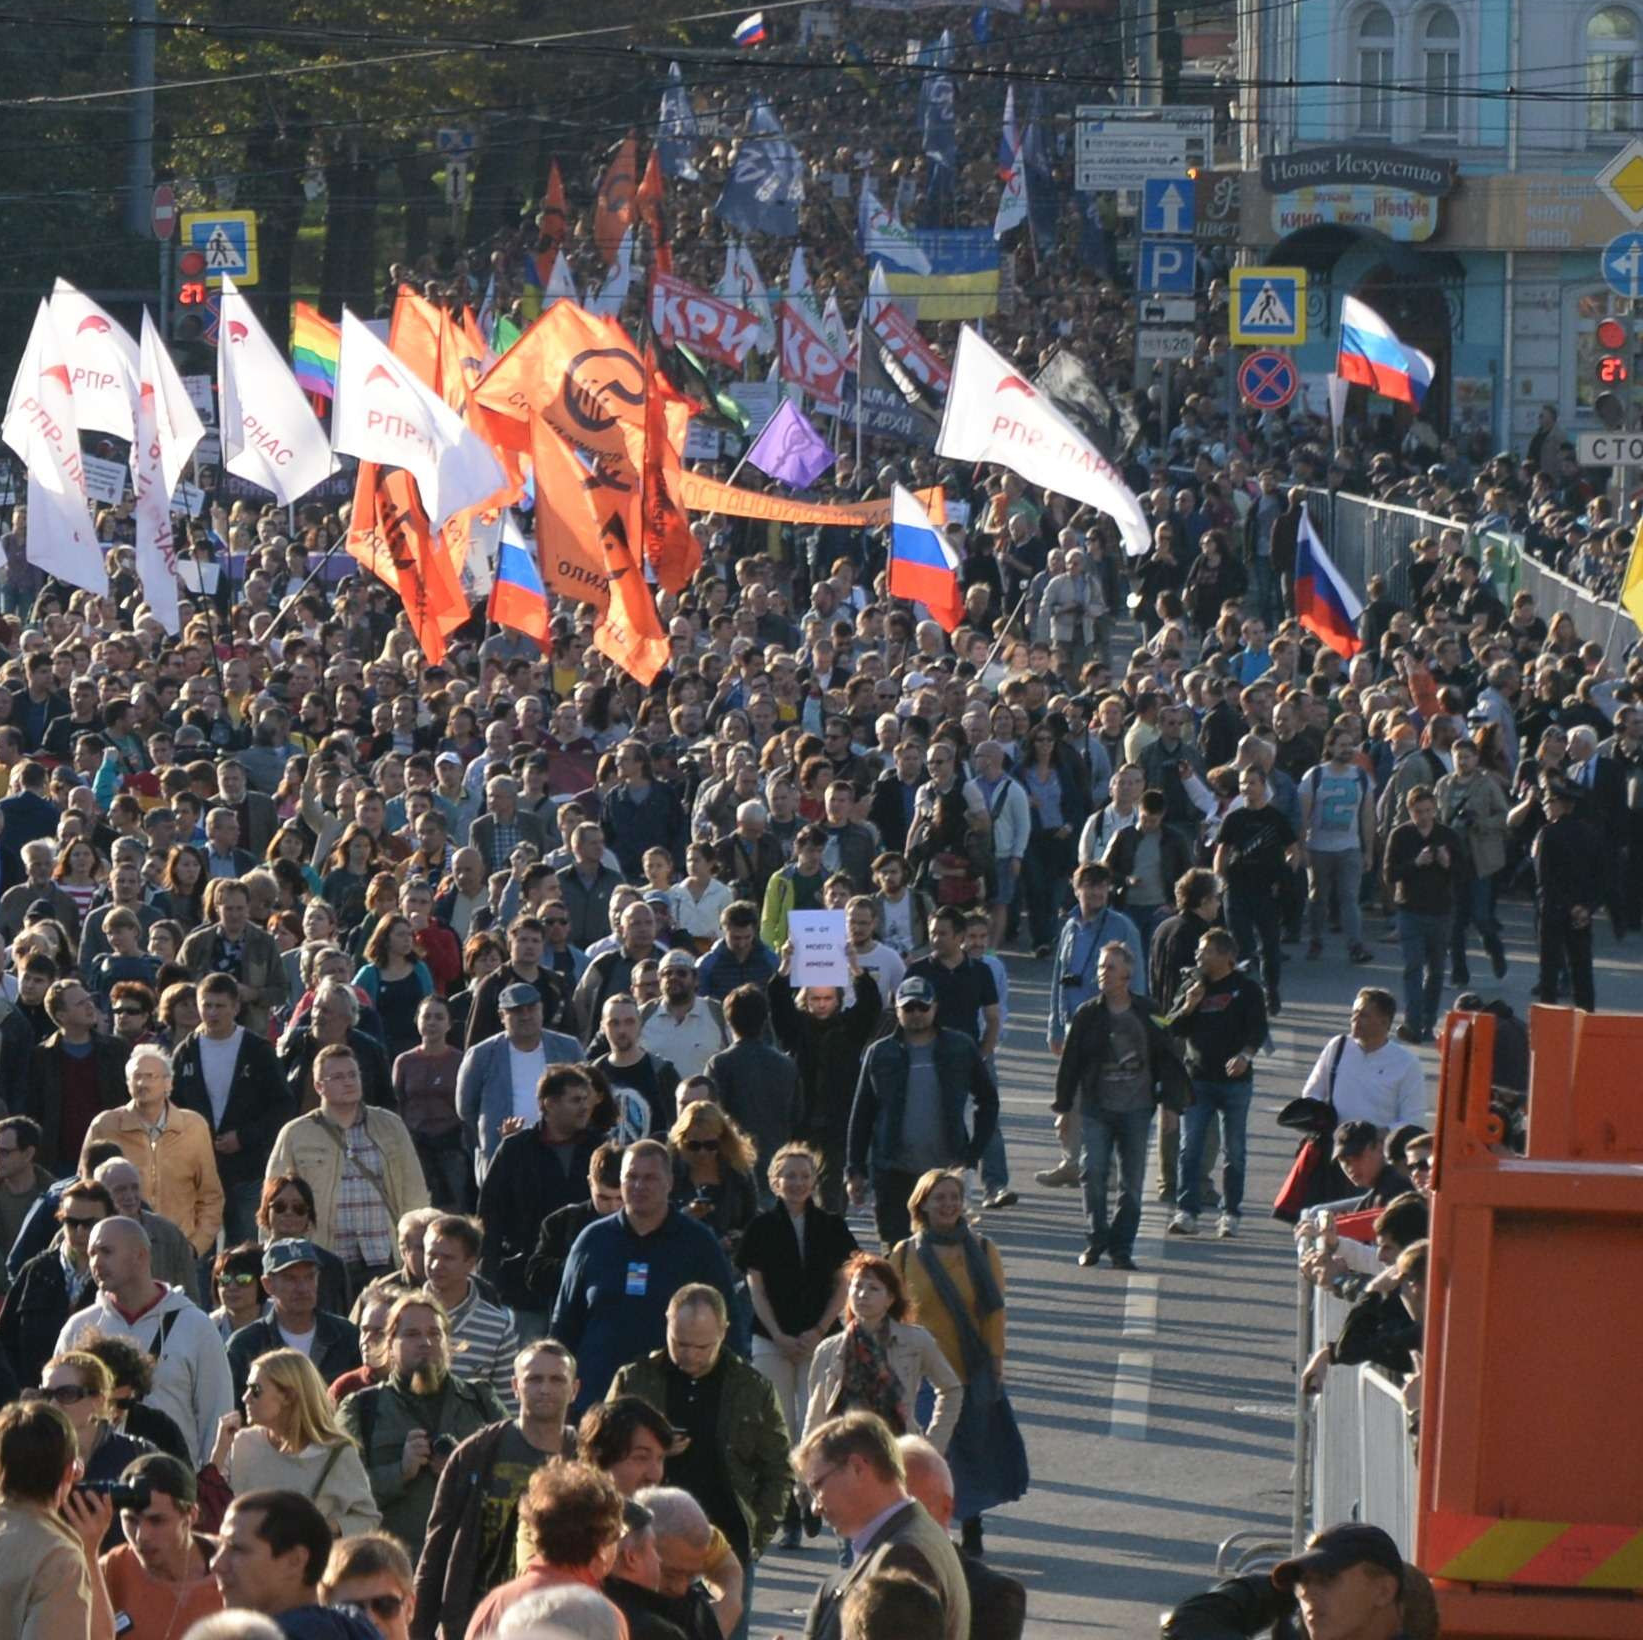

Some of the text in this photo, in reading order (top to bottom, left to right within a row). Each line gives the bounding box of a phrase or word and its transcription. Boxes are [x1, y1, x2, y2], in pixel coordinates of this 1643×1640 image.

[1271, 153, 1442, 185] Новое Искусство
[1373, 198, 1429, 221] lifestyle
[1152, 246, 1182, 290] P
[1322, 777, 1356, 831] 2
